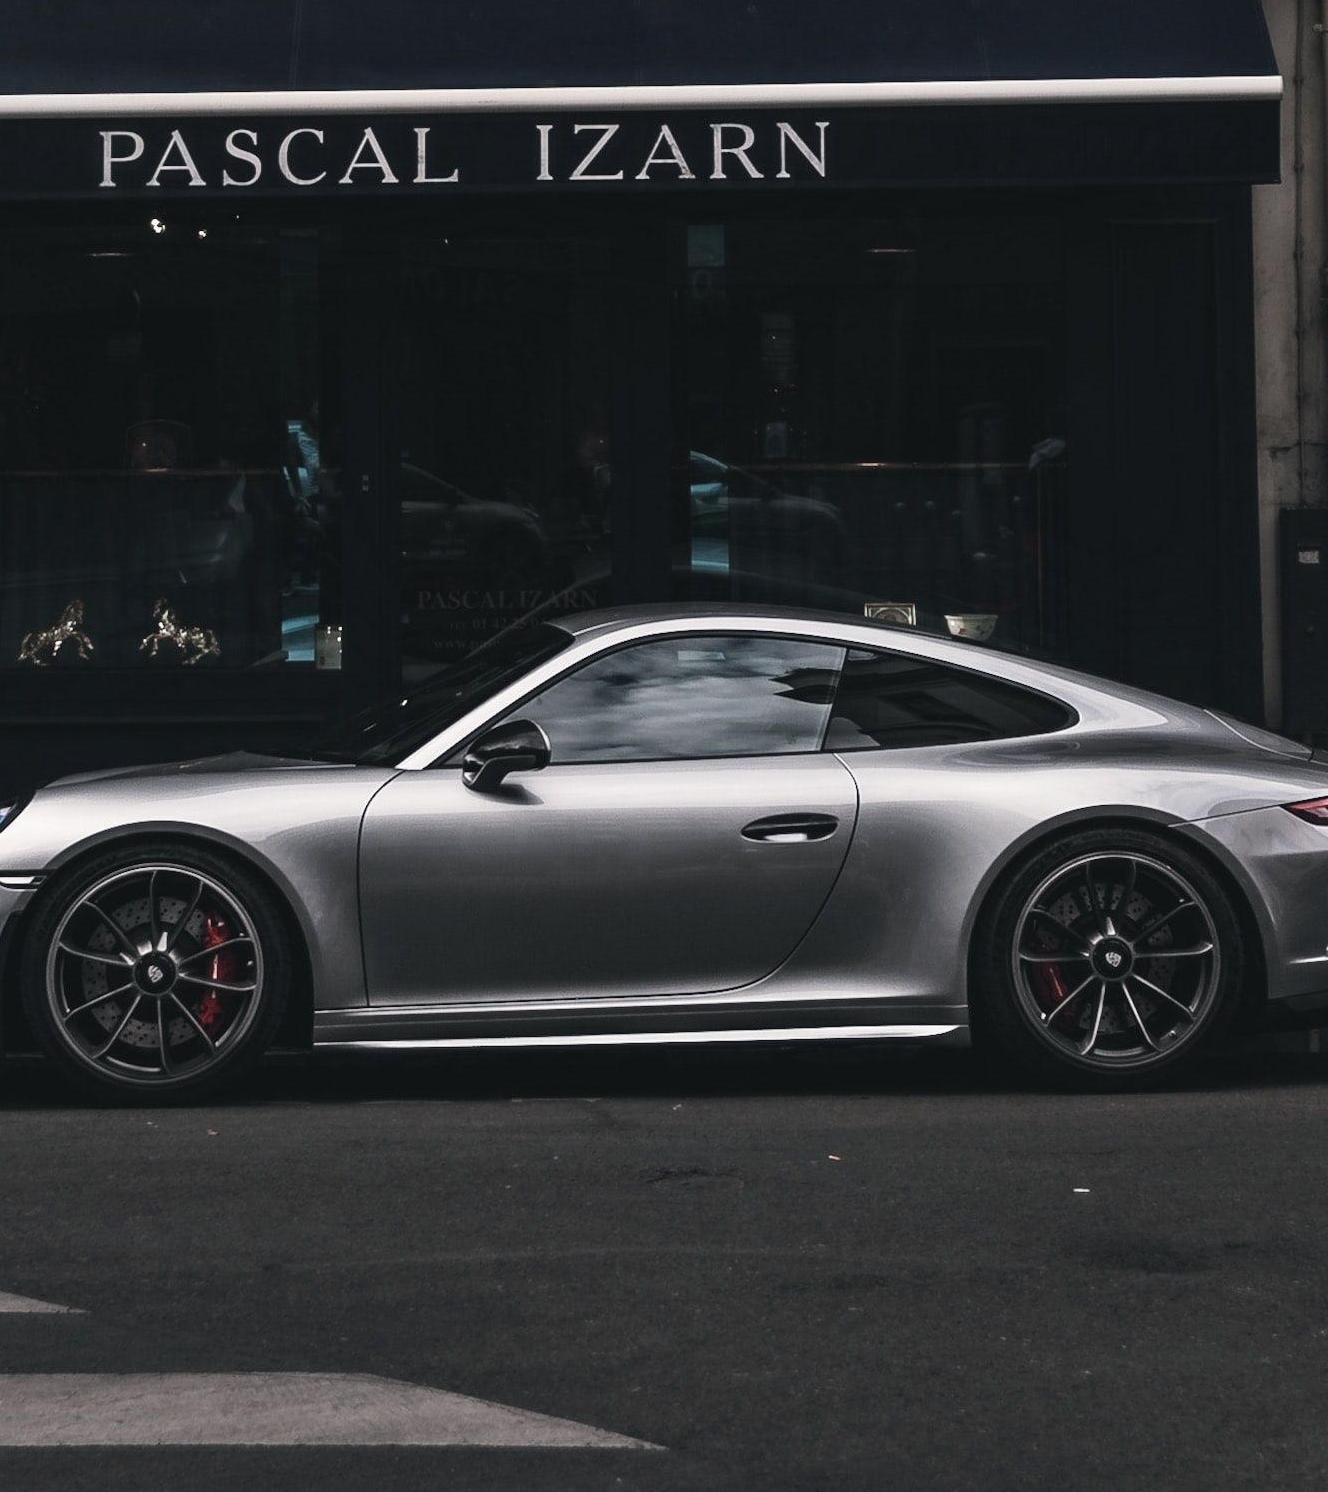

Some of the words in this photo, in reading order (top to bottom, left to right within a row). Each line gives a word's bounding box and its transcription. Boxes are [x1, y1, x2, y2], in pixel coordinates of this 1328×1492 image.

[99, 126, 459, 188] PASCAL
[535, 121, 830, 181] IZARN
[417, 590, 513, 610] PASCAL
[519, 590, 598, 609] IZARN
